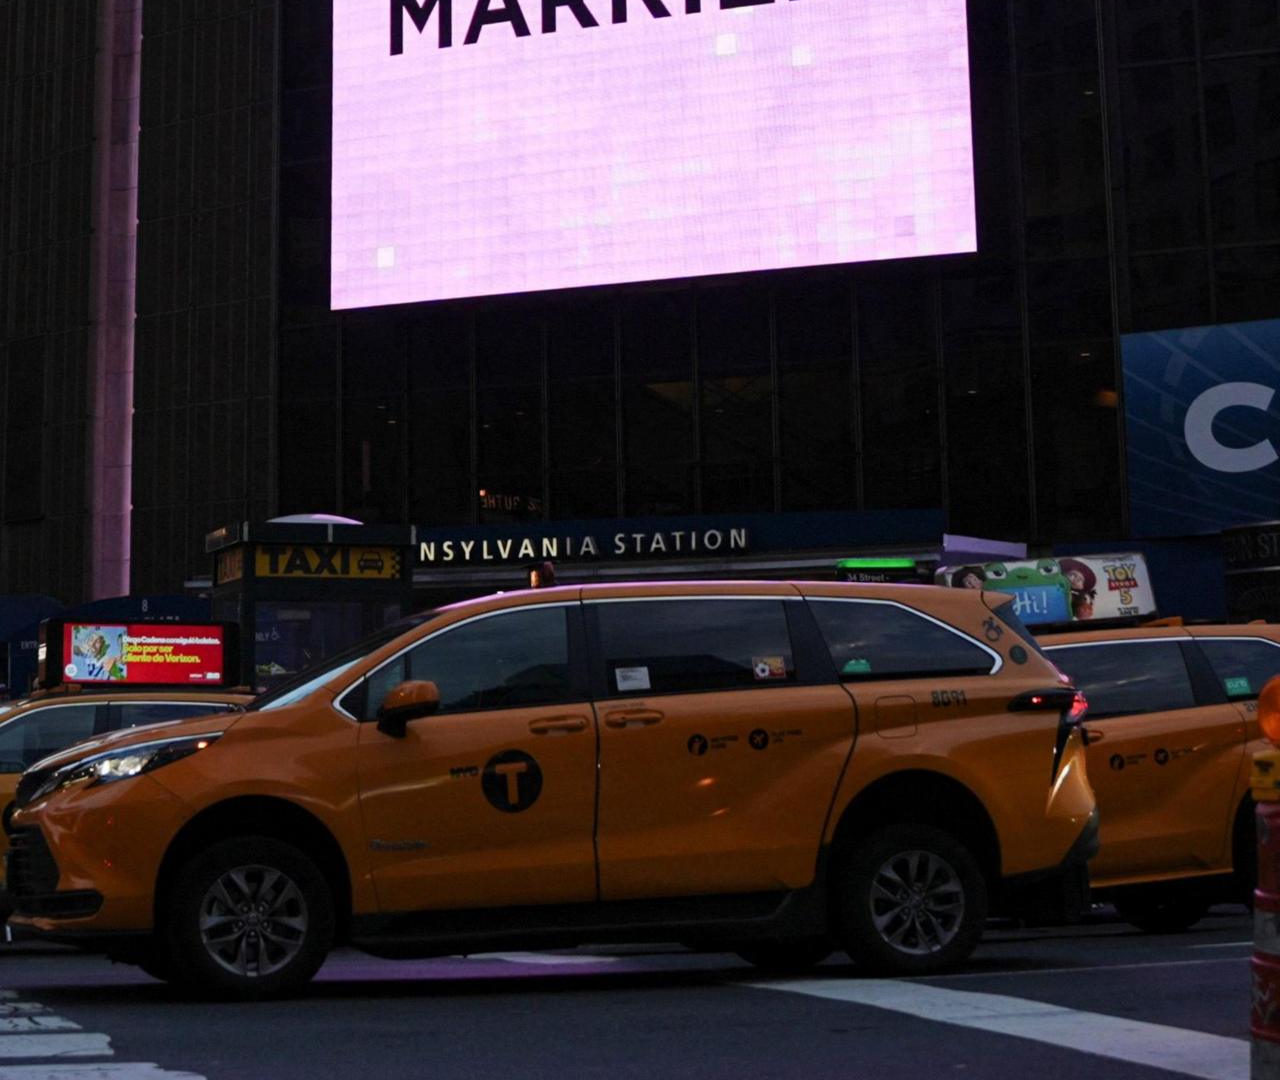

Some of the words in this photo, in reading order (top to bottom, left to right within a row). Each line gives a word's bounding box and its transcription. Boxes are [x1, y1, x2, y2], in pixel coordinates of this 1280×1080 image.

[1184, 381, 1280, 473] C
[263, 544, 351, 575] TAXI
[420, 535, 598, 562] NSYLVANIA
[613, 528, 746, 556] STATION
[1012, 591, 1048, 615] Hi!
